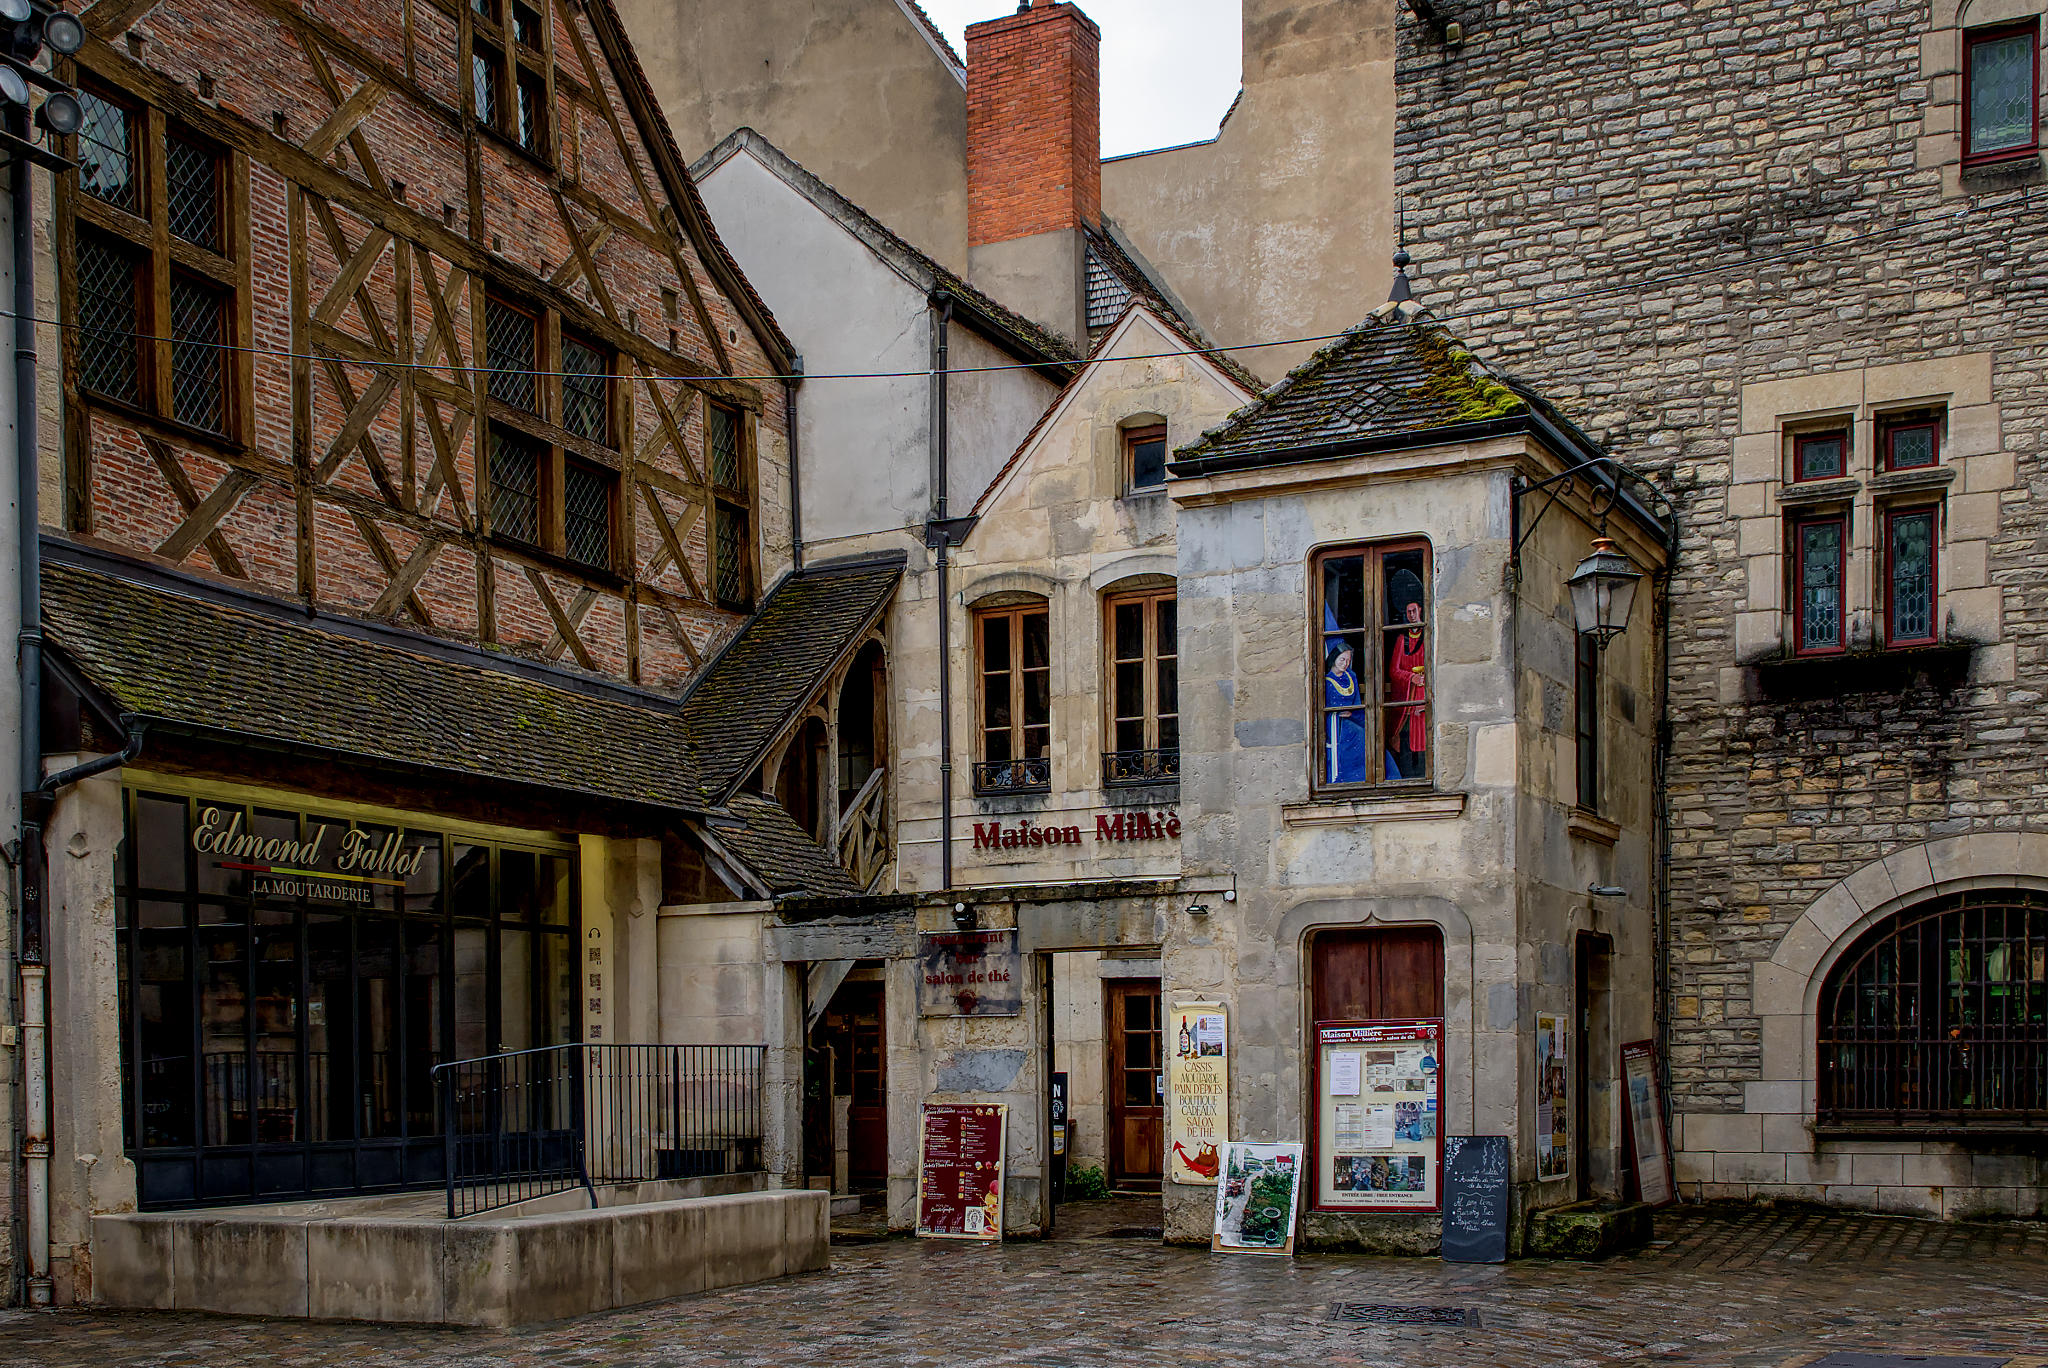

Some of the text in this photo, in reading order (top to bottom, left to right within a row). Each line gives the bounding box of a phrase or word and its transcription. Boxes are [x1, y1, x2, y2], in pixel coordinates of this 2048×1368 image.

[972, 819, 1081, 849] Maison
[192, 807, 426, 876] Edmond Fallot
[252, 879, 371, 903] LA MOUTARDERIE
[925, 968, 1010, 985] salon de thé
[1322, 1030, 1351, 1039] Maison
[1352, 1029, 1382, 1038] Millière
[1184, 1062, 1213, 1073] CASSIS
[1180, 1073, 1219, 1083] MOUTARDE
[1174, 1083, 1191, 1095] PAIN
[1179, 1095, 1217, 1106] BOUTIQUE
[1181, 1105, 1217, 1116] CADEAUX
[1186, 1117, 1214, 1127] SALON
[1187, 1126, 1198, 1137] DE
[1216, 1164, 1227, 1218] JARDIN
